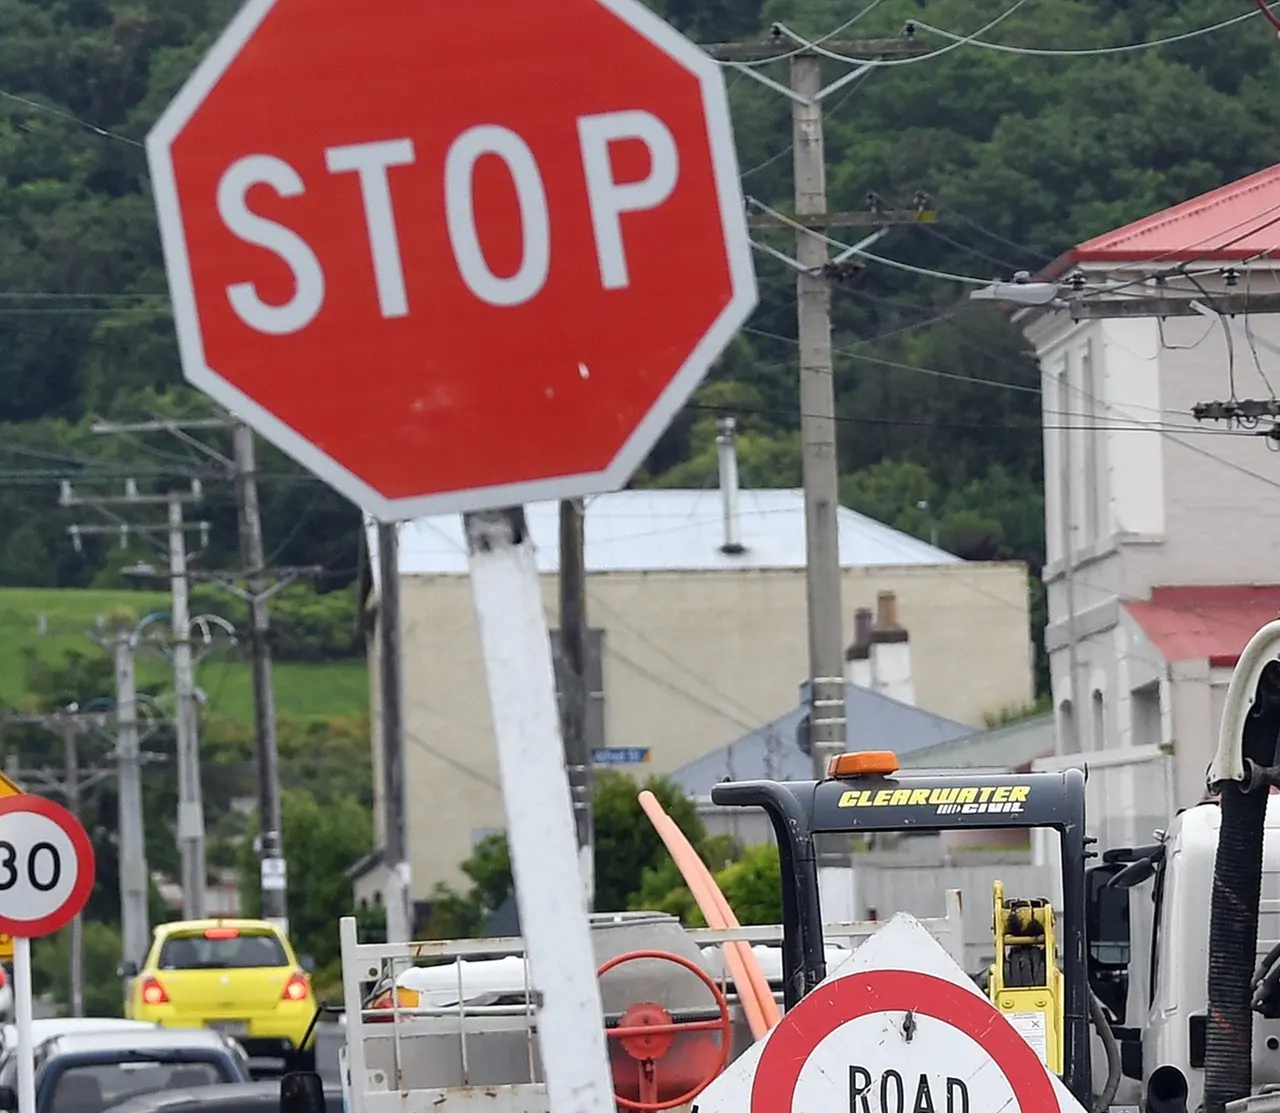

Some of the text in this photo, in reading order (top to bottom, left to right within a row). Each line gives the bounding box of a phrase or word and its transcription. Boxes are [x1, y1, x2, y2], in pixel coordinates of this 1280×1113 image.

[216, 109, 680, 335] STOP
[838, 785, 1031, 808] CLEARWATER
[961, 802, 1025, 814] CIVIL
[0, 841, 61, 891] 30
